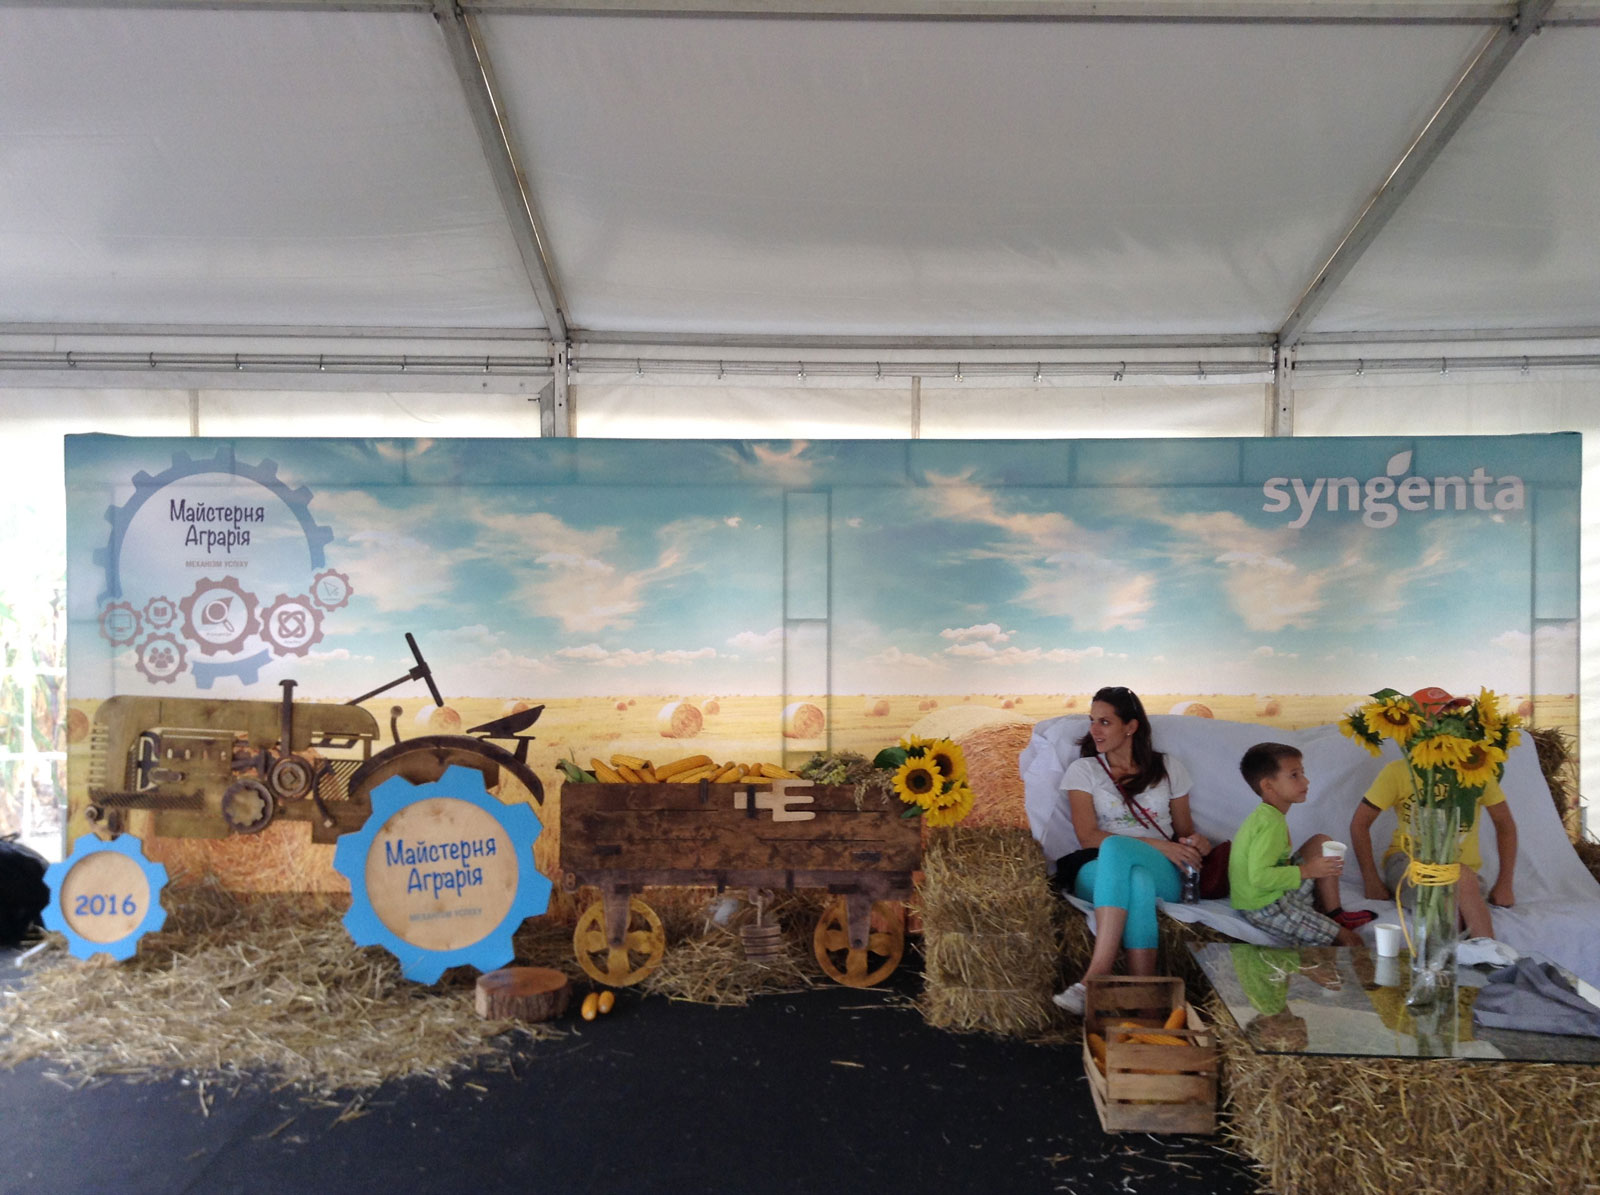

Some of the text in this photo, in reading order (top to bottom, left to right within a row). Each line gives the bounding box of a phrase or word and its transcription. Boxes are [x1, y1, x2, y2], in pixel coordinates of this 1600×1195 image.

[1262, 467, 1525, 529] syngenta
[170, 498, 265, 530] Майстерня
[185, 524, 250, 554] Аграрія
[385, 837, 497, 868] Майстерня
[407, 864, 483, 899] Аграрія
[75, 893, 137, 916] 2016
